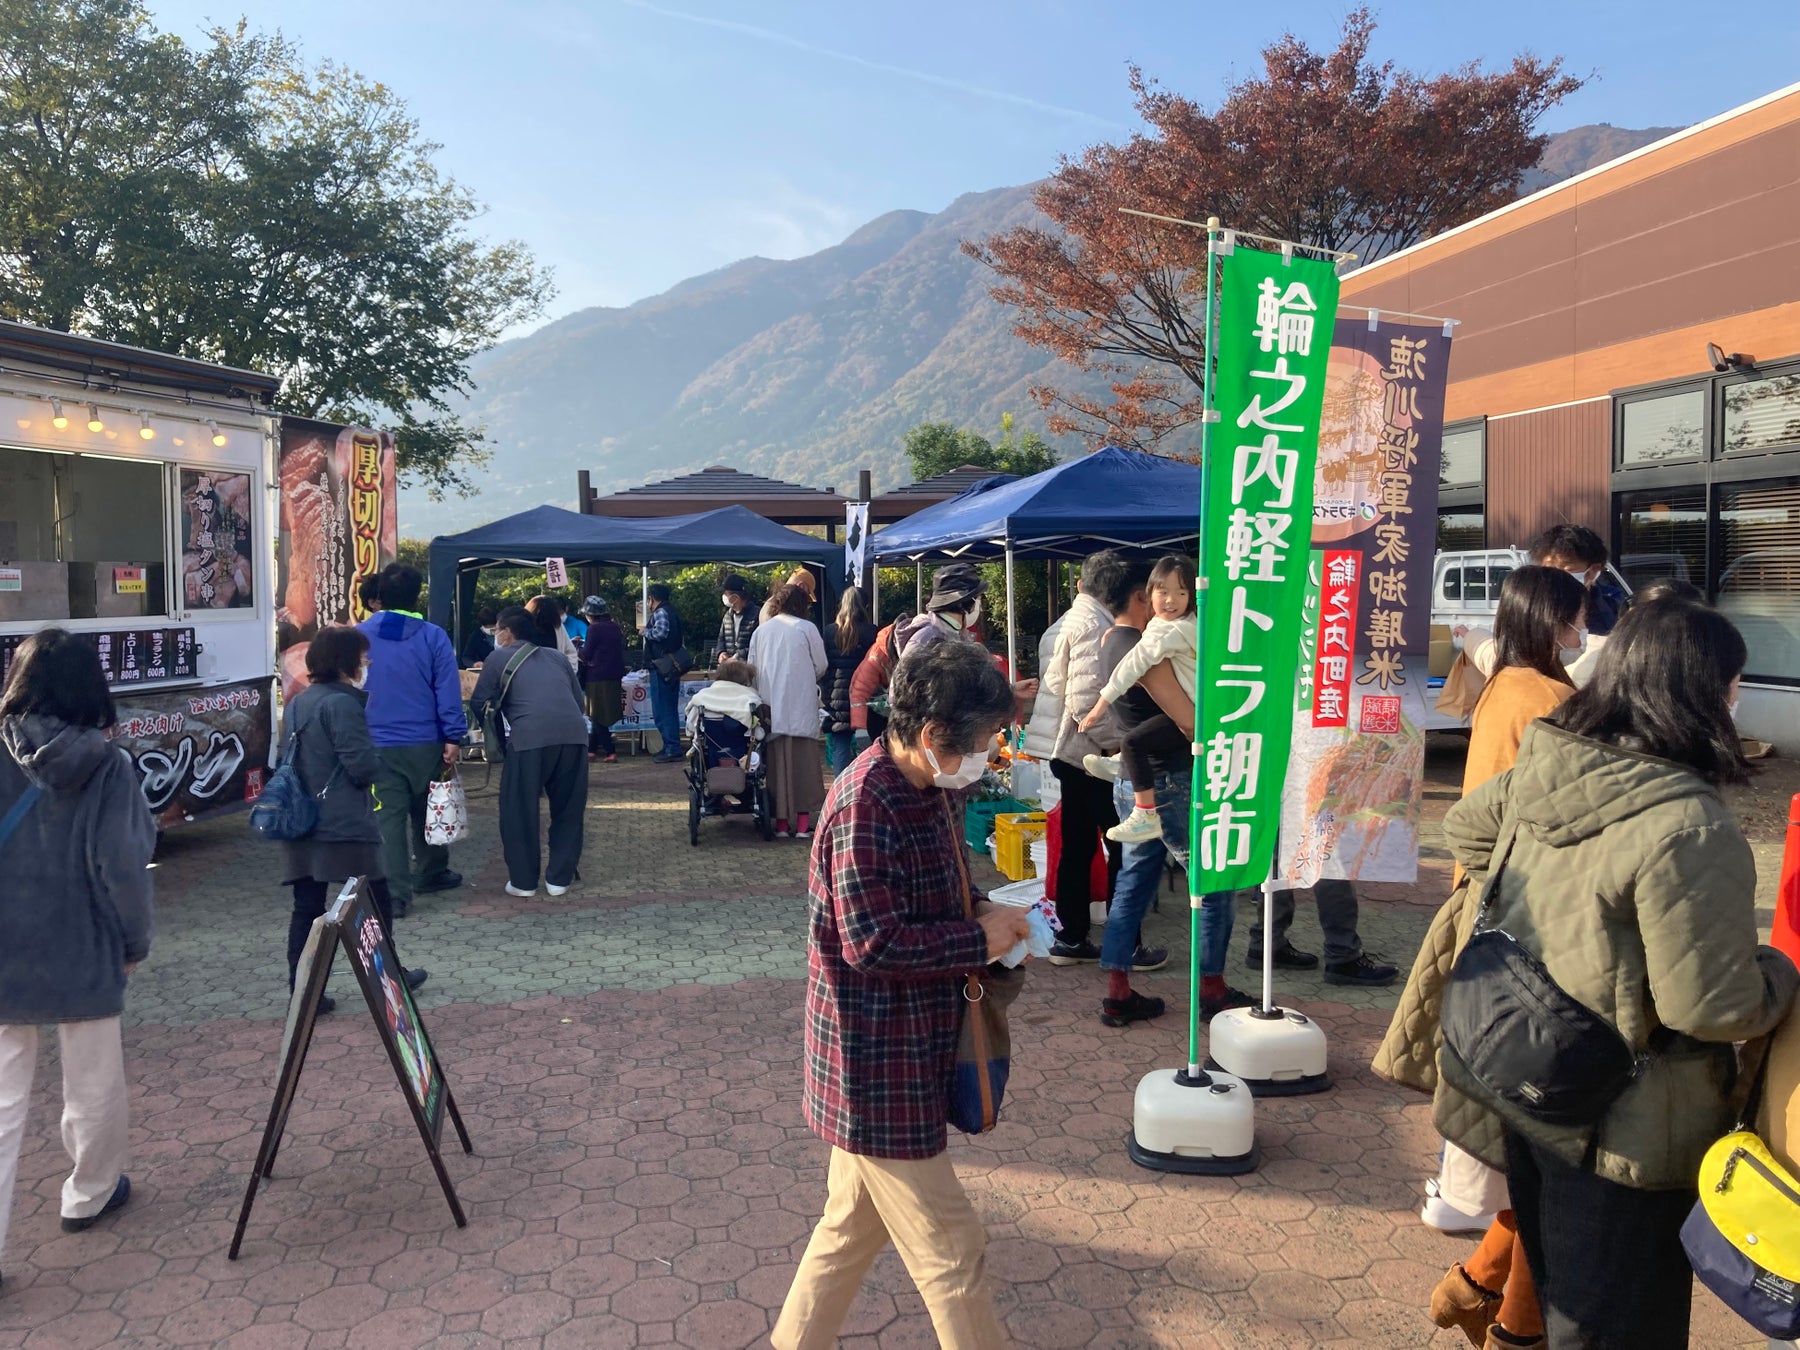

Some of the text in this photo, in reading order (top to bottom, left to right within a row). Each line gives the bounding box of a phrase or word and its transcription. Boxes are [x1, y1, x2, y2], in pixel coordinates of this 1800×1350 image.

[190, 475, 215, 602] 厚切り塩タン串
[1201, 276, 1317, 873] 輪之内軽トラ朝市
[126, 632, 137, 669] 上ロース串
[120, 669, 140, 680] 800円
[147, 667, 166, 677] 600円
[188, 689, 260, 714] 溢れ出す旨み
